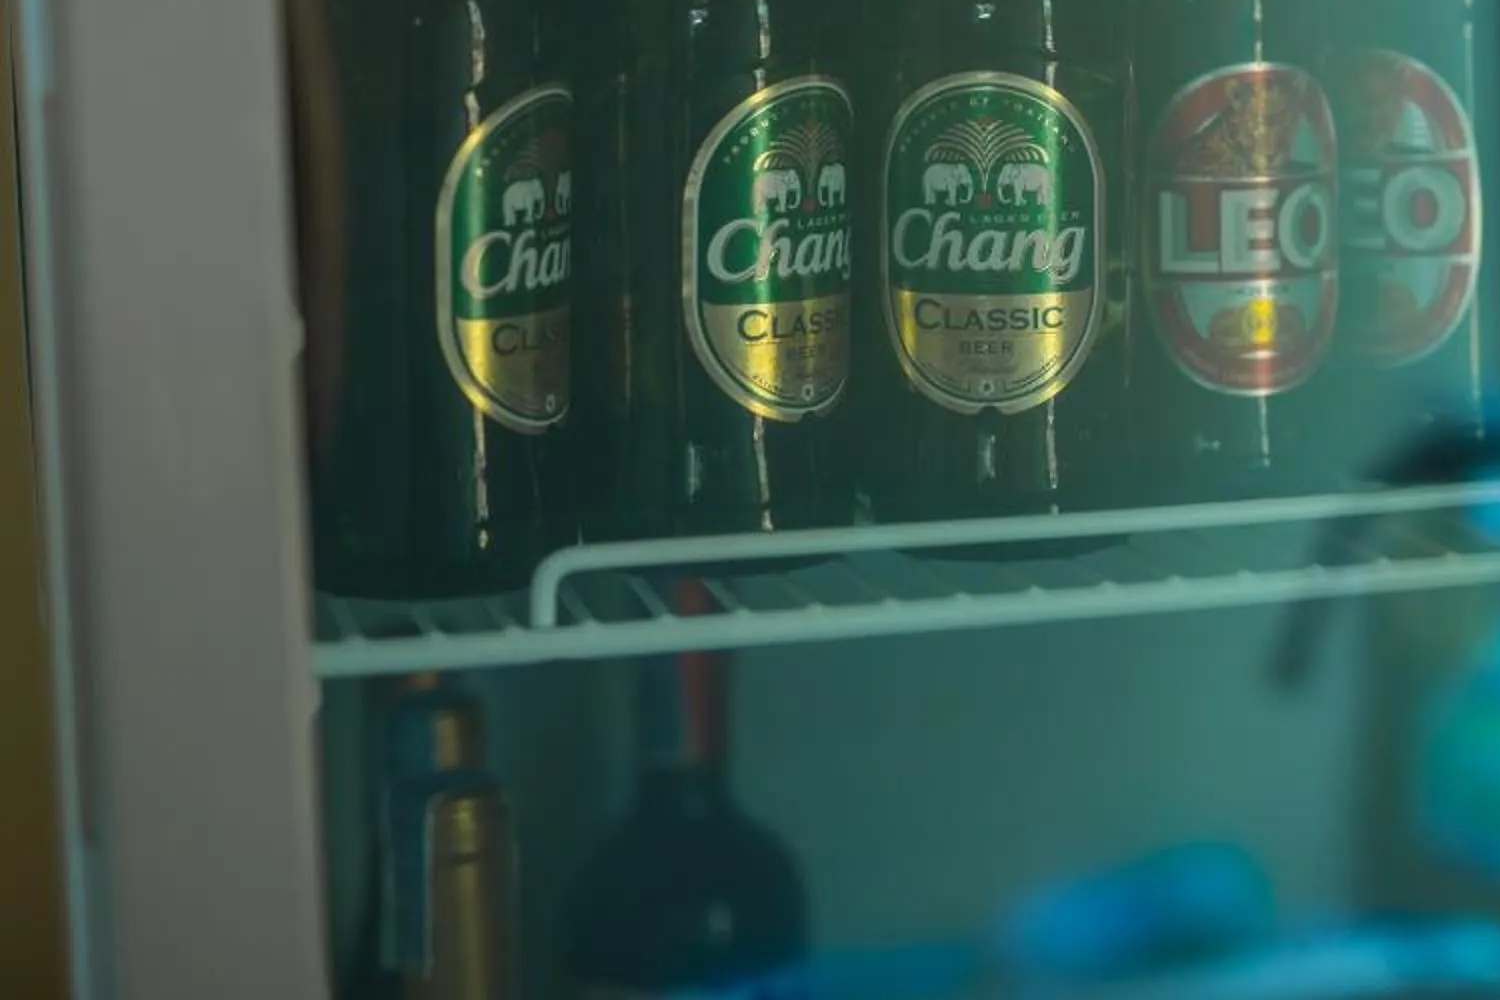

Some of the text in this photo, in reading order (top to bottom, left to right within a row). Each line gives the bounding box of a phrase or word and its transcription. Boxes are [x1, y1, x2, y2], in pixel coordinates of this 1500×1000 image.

[893, 207, 1086, 285] Chang
[1160, 182, 1328, 274] LEO
[1346, 165, 1466, 251] EO
[460, 229, 572, 299] Cha
[737, 308, 850, 341] CLASS
